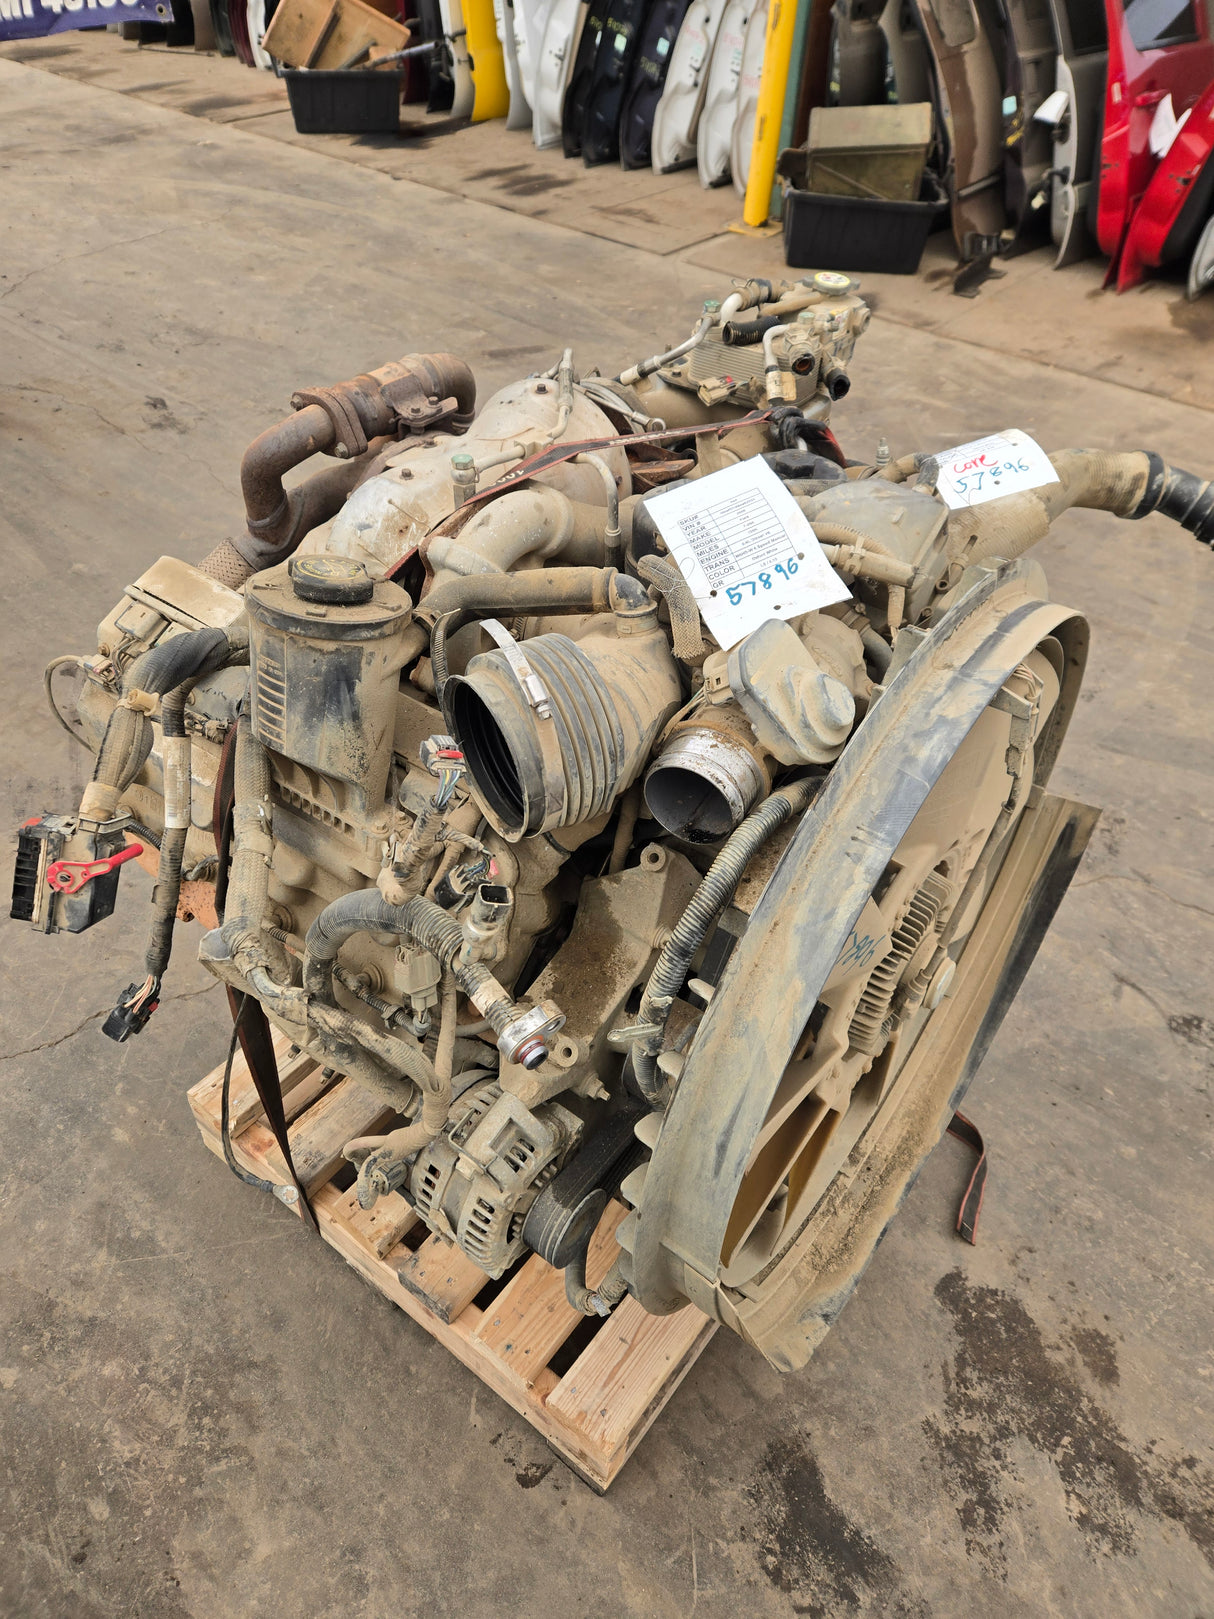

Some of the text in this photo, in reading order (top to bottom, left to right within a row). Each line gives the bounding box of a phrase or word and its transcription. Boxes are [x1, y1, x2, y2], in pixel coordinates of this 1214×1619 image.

[953, 458, 1030, 494] 57896
[687, 525, 707, 537] YEAR
[689, 531, 712, 544] MAKE
[692, 536, 721, 550] MODEL
[696, 543, 720, 557] MILES
[700, 548, 729, 565] ENGINE
[705, 557, 730, 572] TRANS
[708, 565, 736, 580] COLOR
[712, 579, 725, 589] GR
[725, 557, 799, 606] 57896
